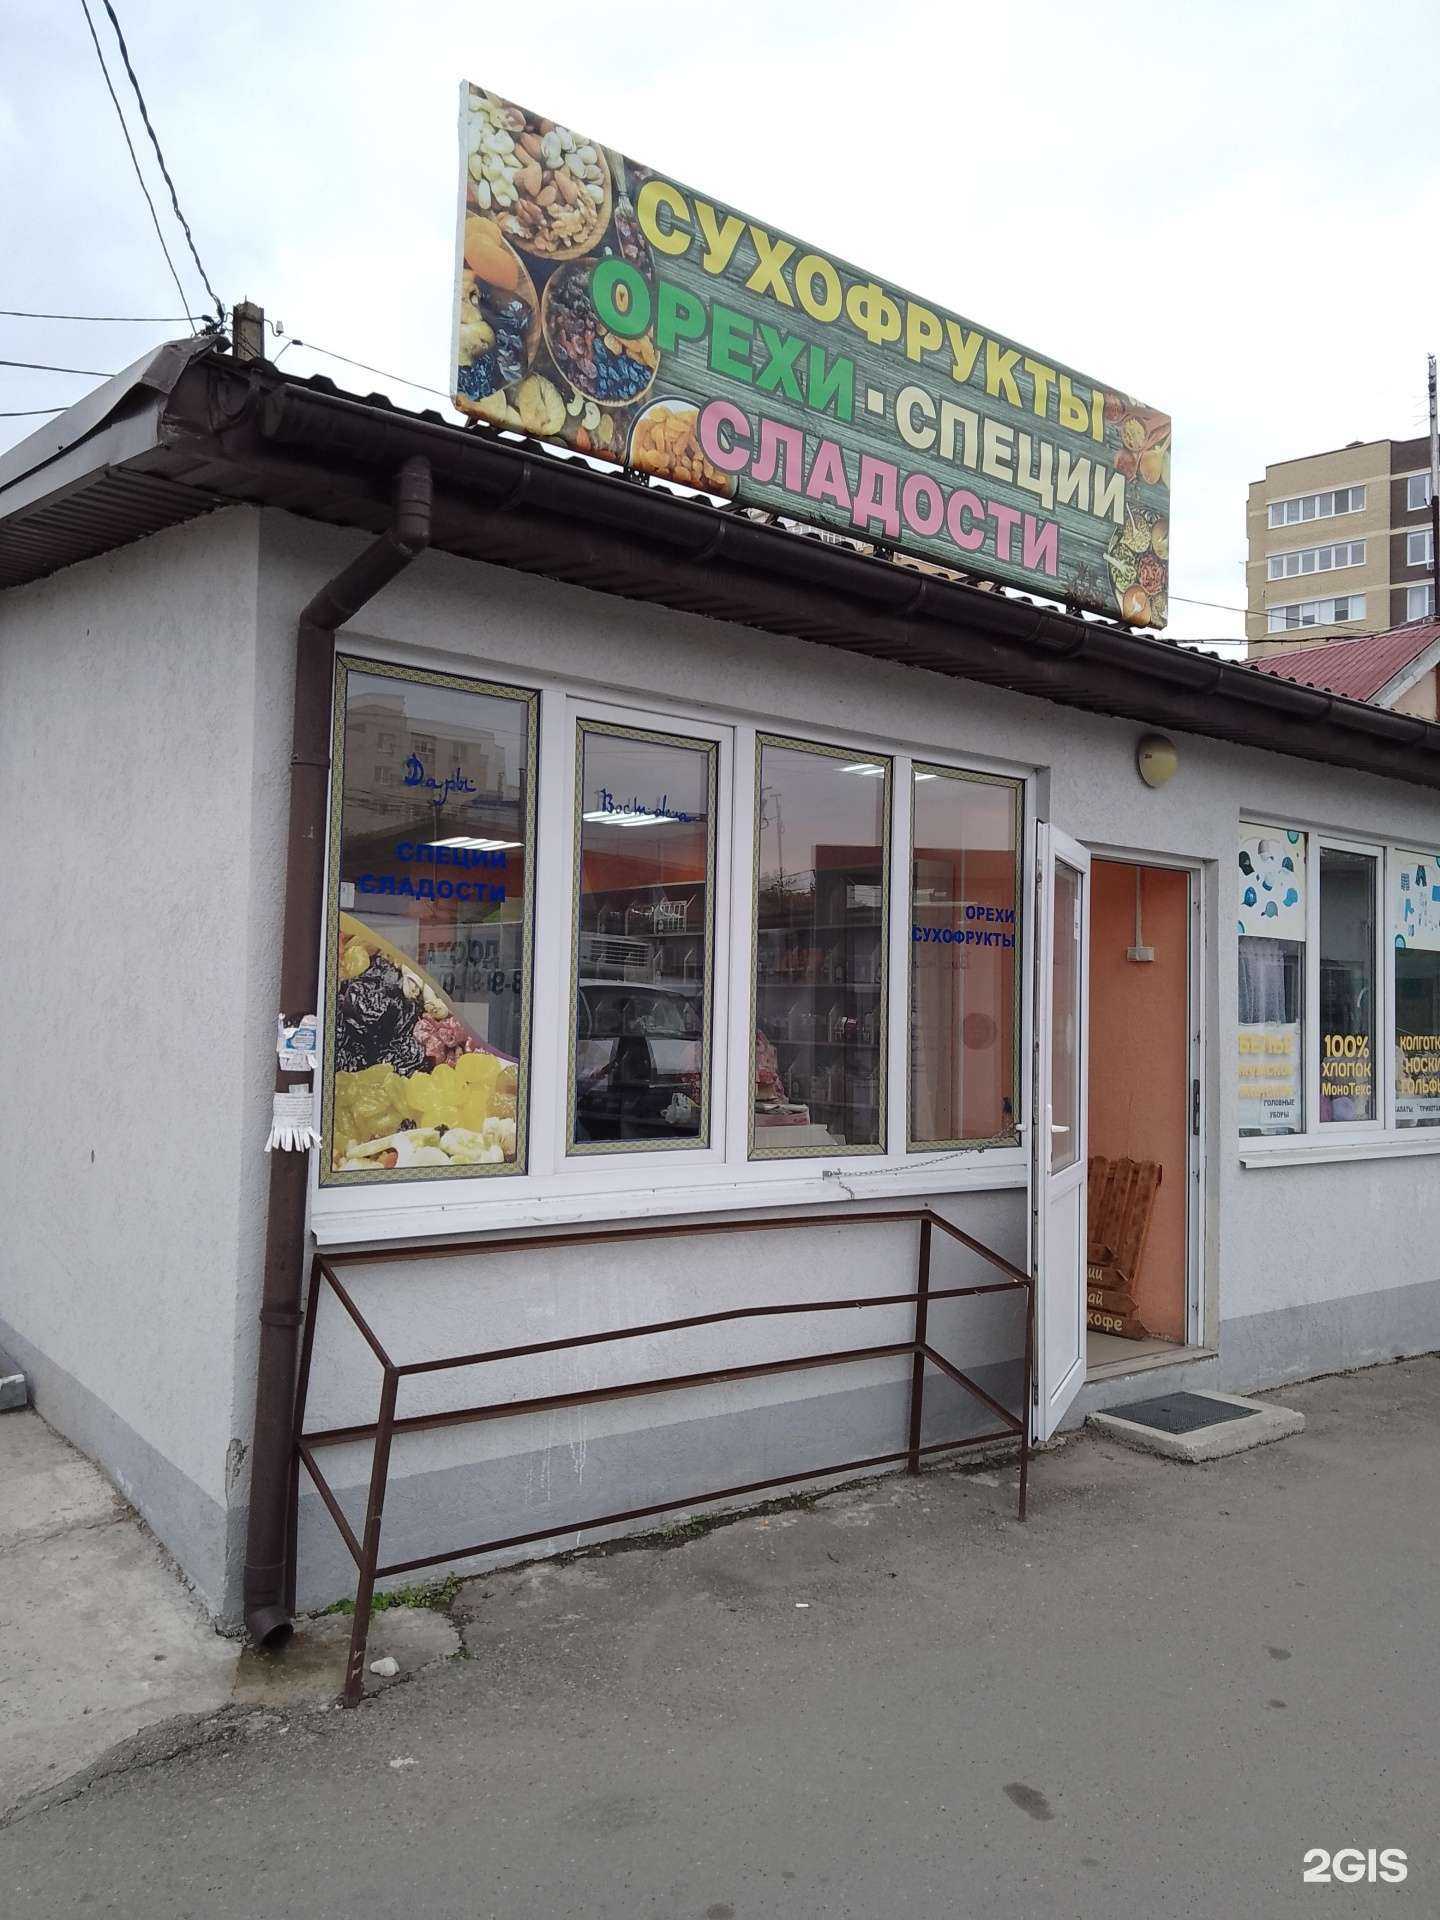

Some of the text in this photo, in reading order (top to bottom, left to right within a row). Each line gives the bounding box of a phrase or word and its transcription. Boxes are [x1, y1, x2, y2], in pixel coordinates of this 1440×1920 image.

[636, 180, 1106, 443] СУХОФРУКТЫ
[591, 256, 855, 424] ОРЕХИ
[896, 385, 1126, 526] СПЕЦИИ
[699, 400, 1060, 577] СЛАДОСТИ
[395, 840, 507, 871] СПЕЦИИ
[356, 873, 506, 903] СЛАДОСТИ
[965, 905, 1016, 924] ОРЕХИ
[912, 925, 1016, 948] СУХОФРУКТЫ
[1325, 1034, 1370, 1058] 100%
[1322, 1062, 1371, 1077] ХЛОПОК
[1322, 1082, 1372, 1096] МоноТекс
[1087, 1289, 1104, 1306] ай
[1087, 1313, 1123, 1331] кофе
